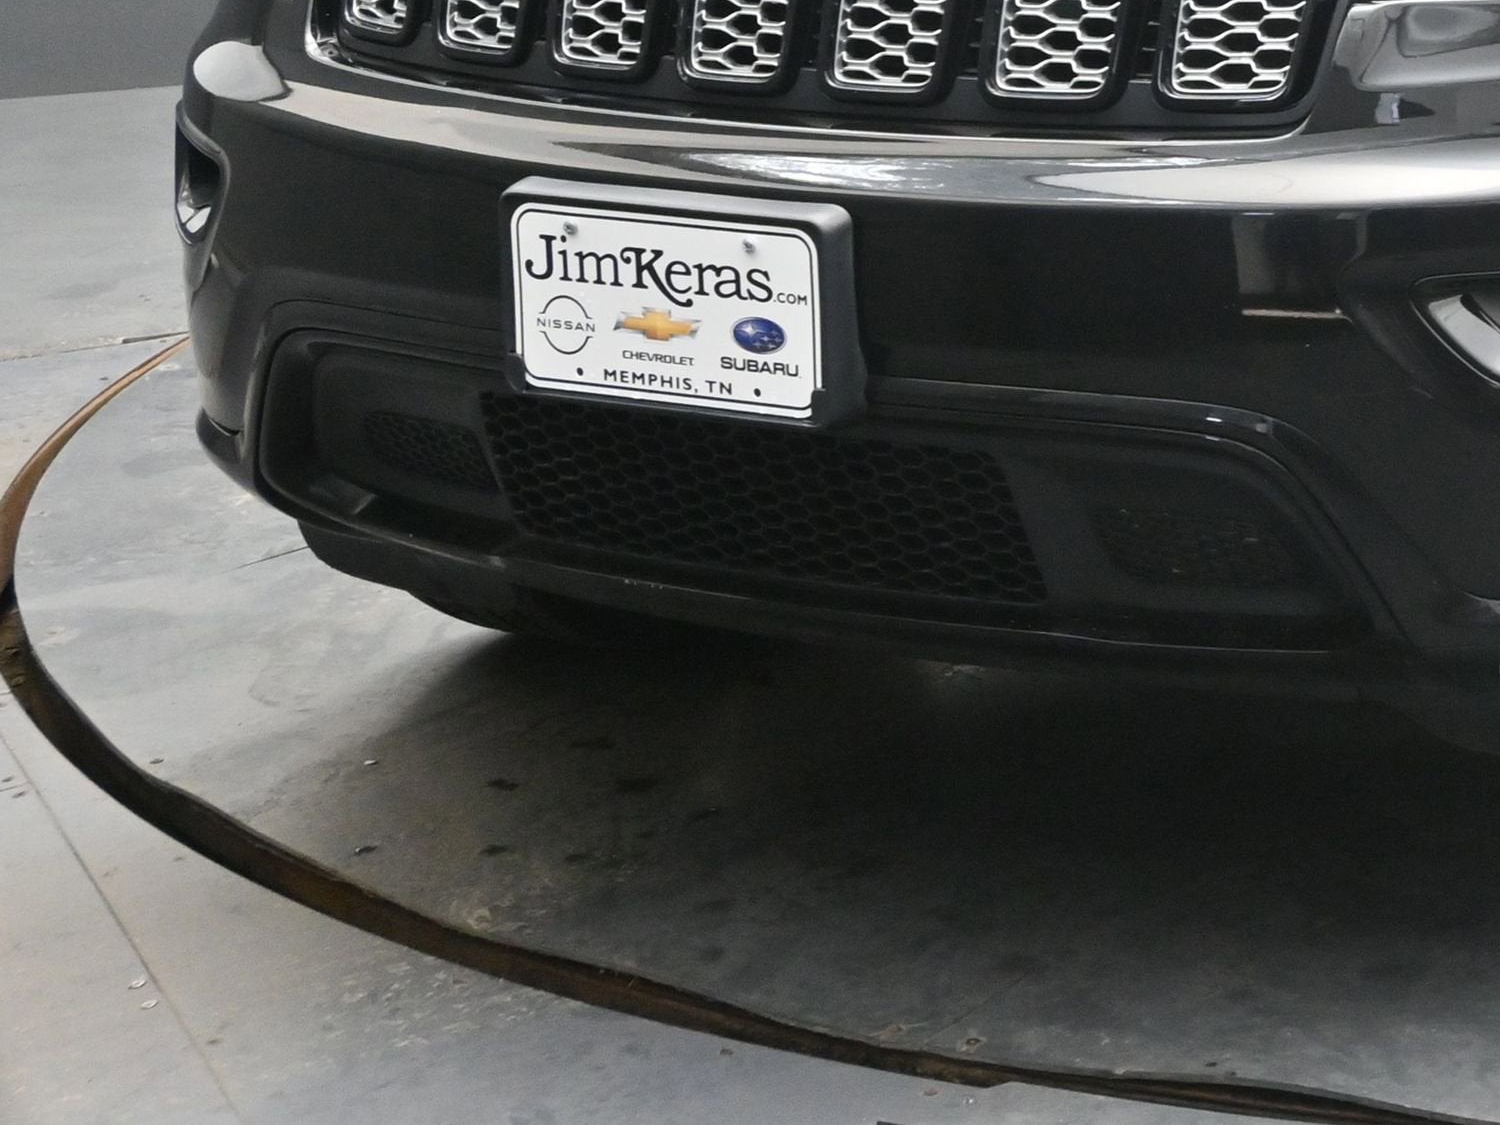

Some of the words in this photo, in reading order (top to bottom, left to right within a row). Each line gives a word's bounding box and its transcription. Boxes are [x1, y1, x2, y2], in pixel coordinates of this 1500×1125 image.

[536, 317, 596, 334] NISSAN
[621, 349, 695, 367] CHEVROLET
[720, 356, 800, 378] SUBARU
[603, 368, 699, 394] MEMPHIS,
[705, 379, 733, 396] TN
